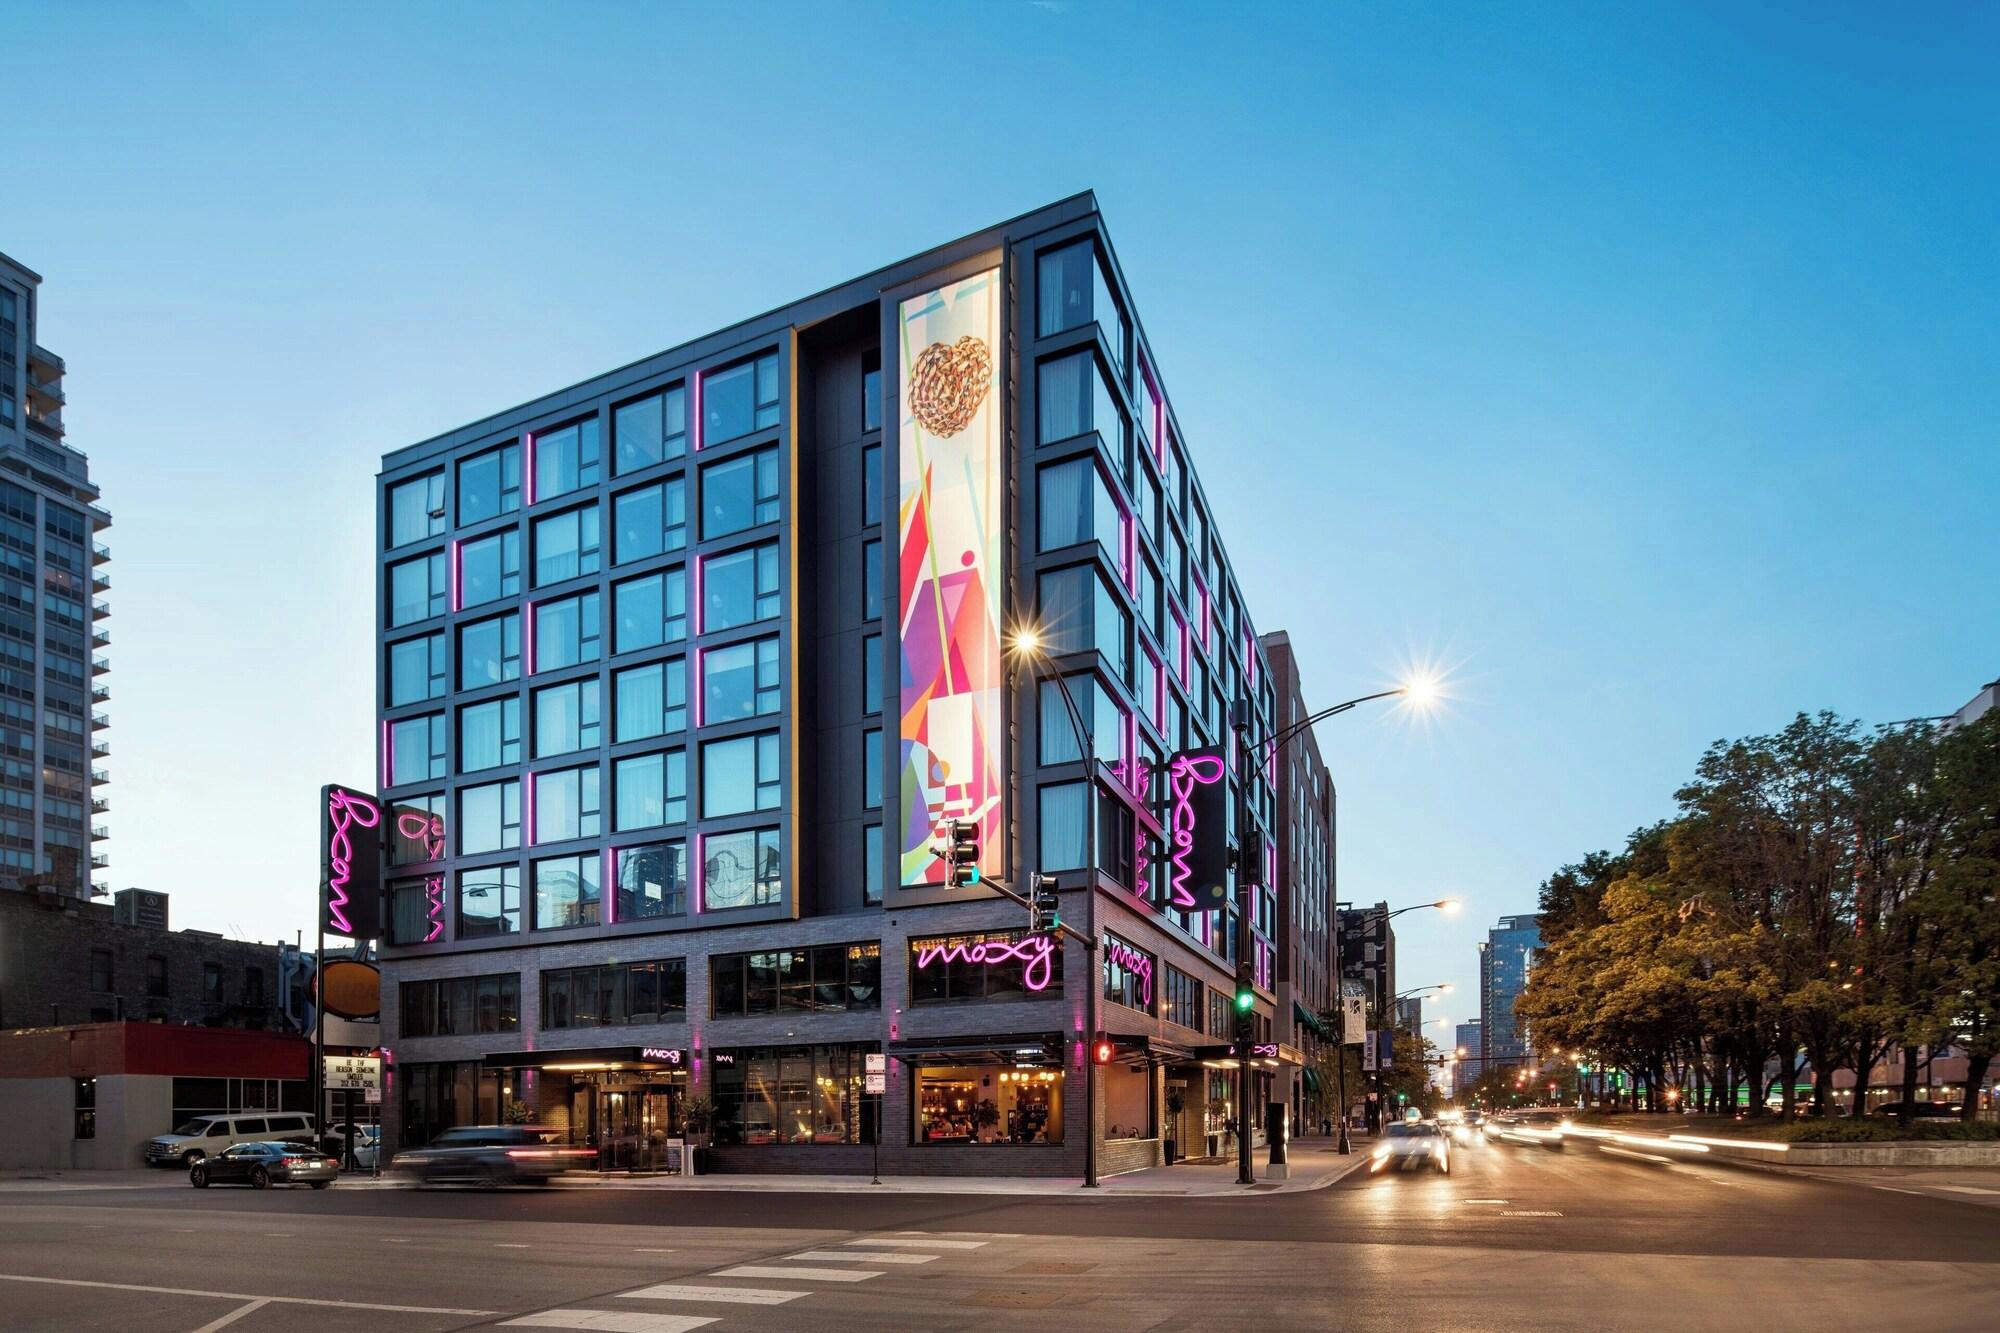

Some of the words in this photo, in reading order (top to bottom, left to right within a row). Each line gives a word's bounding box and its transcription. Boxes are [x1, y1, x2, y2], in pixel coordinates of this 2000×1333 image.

[329, 789, 380, 933] moxy
[1171, 756, 1224, 907] moxy
[918, 935, 1055, 991] moxy
[1110, 943, 1153, 1006] moxy
[336, 1065, 353, 1073] REASON
[356, 1066, 375, 1074] SOMEONE
[643, 1048, 681, 1063] moxy
